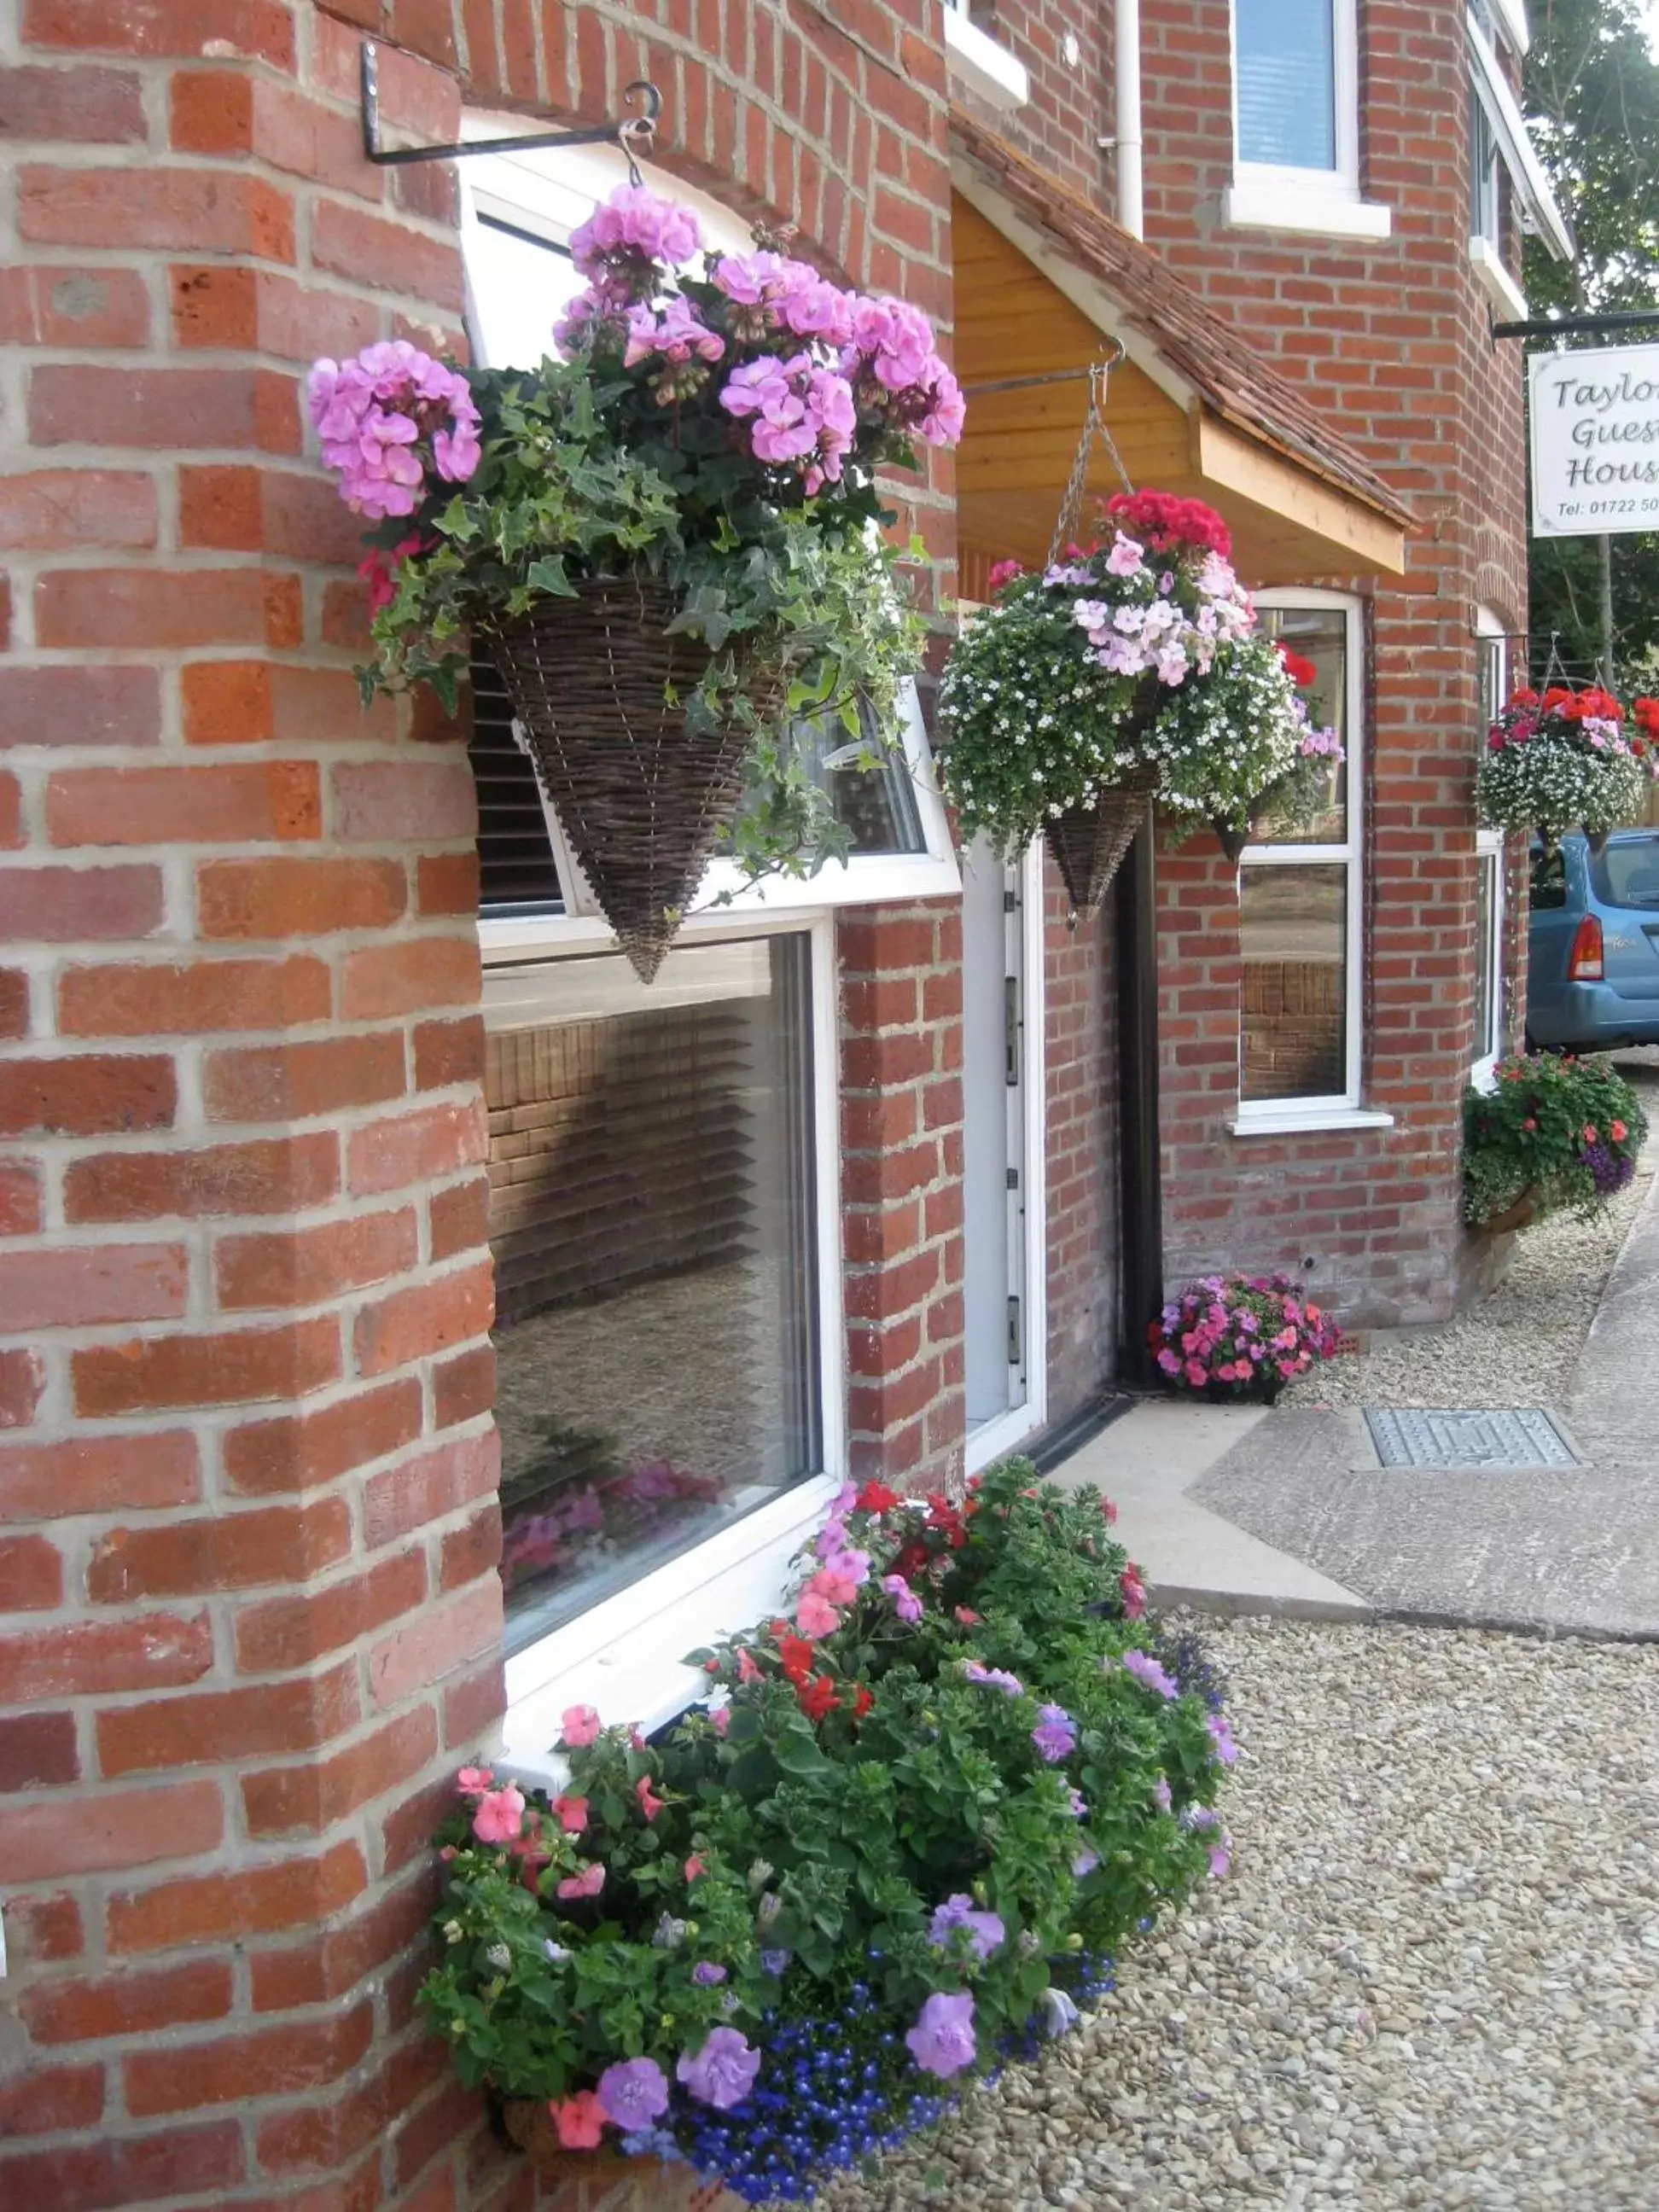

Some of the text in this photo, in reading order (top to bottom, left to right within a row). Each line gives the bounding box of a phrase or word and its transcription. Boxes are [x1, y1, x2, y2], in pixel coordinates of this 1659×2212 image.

[1553, 372, 1659, 413] Taylo
[1572, 418, 1659, 449] Gues
[1566, 456, 1659, 487] Hous
[1558, 498, 1659, 516] Tel: 01722 50
